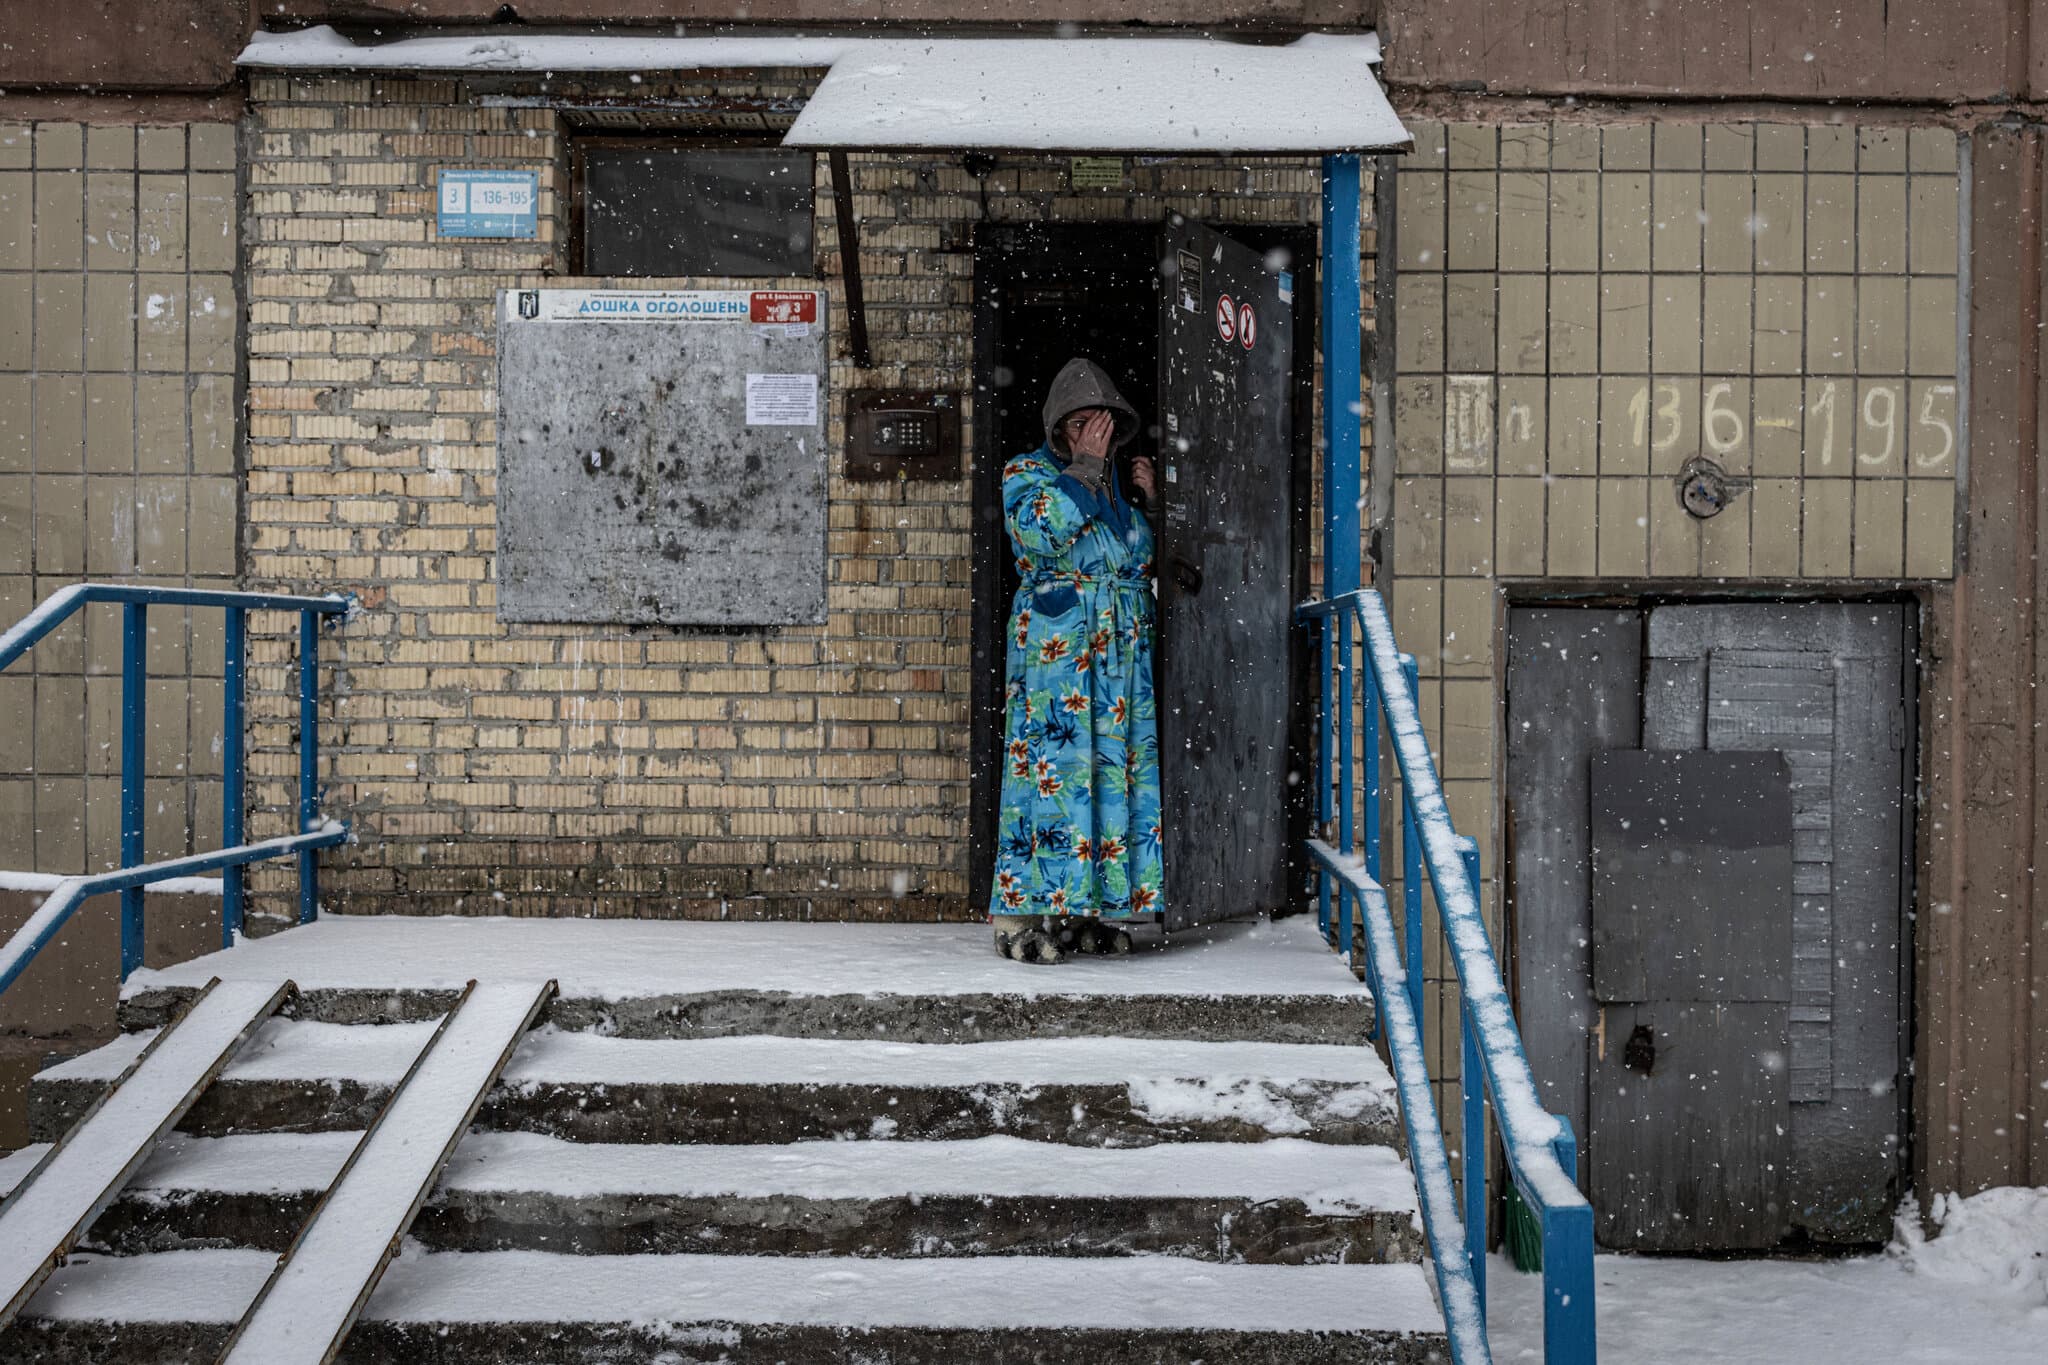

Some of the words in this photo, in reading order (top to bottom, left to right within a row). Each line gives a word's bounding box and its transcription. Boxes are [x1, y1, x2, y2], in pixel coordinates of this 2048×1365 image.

[450, 188, 458, 204] 3
[483, 191, 528, 205] 136-195
[578, 300, 640, 313] ДОШКА
[646, 300, 749, 314] ОГОЛОШЕНЬ
[794, 302, 801, 313] 3
